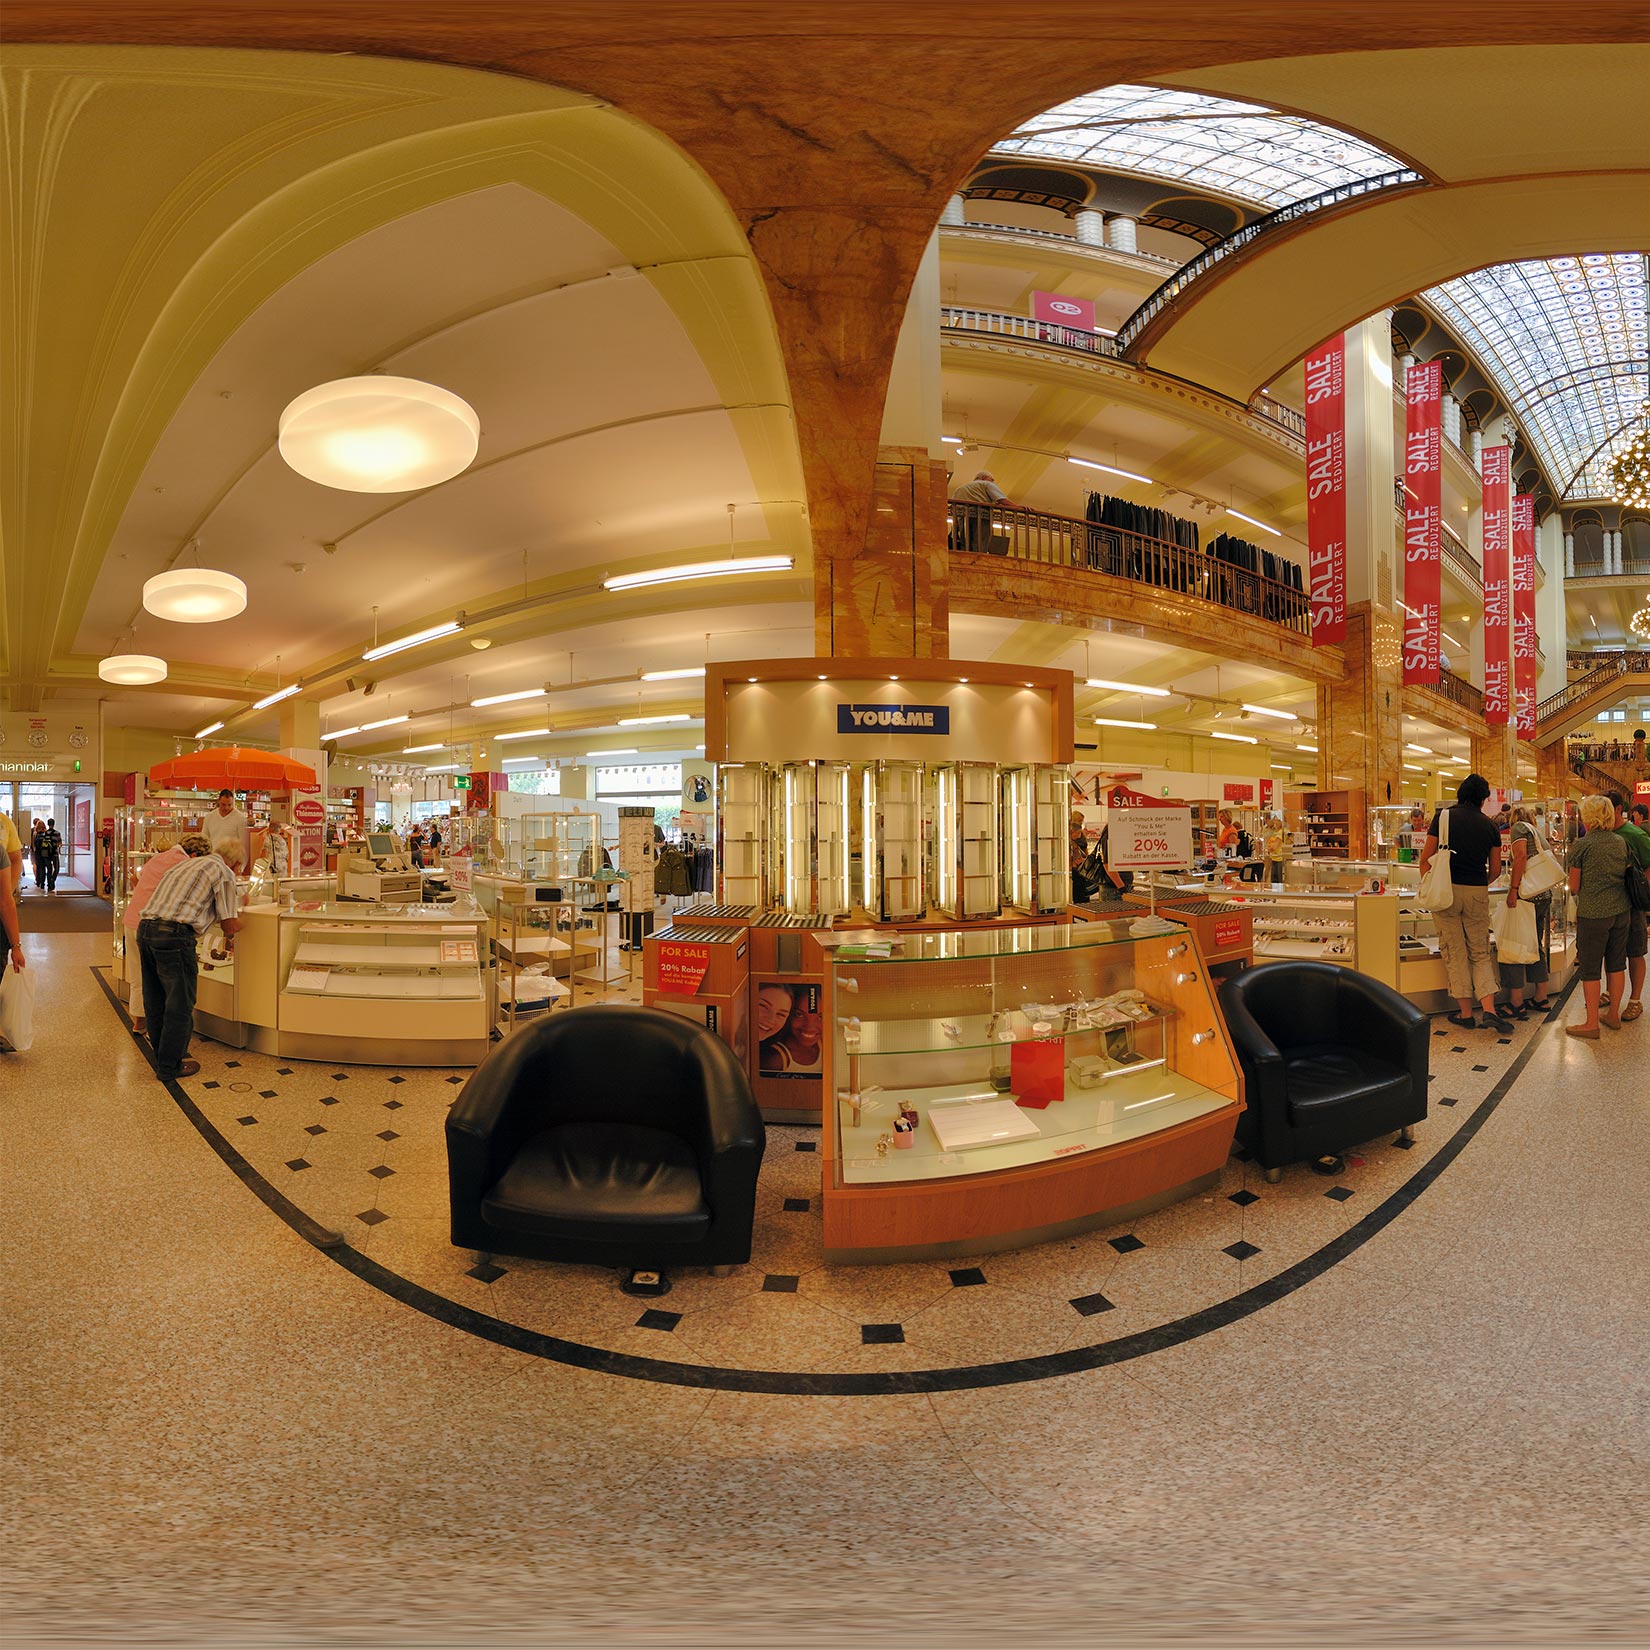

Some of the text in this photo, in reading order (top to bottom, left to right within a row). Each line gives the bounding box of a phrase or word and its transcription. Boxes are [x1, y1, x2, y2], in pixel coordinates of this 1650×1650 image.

[1307, 354, 1331, 404] SALE
[1333, 352, 1342, 395] REDUZIERT
[1409, 367, 1429, 406] SALE
[1430, 366, 1438, 400] REDUZIERT
[1309, 434, 1332, 499] SALE
[1333, 432, 1342, 491] REDUZIERT
[1408, 429, 1429, 473] SALE
[1430, 427, 1438, 471] REDUZIERT
[1484, 450, 1500, 485] SALE
[1407, 507, 1429, 561] SALE
[1430, 506, 1438, 560] REDUZIERT
[1484, 510, 1501, 550] SALE
[1512, 499, 1526, 532] SALE
[1311, 544, 1333, 627] SALE
[1335, 543, 1343, 623] REDUZIERT
[1513, 554, 1527, 591] SALE
[1485, 580, 1501, 626] SALE
[1404, 603, 1428, 669] SALE
[1429, 604, 1437, 669] REDUZIERT
[1514, 618, 1528, 658] SALE
[1486, 661, 1501, 711] SALE
[850, 711, 934, 727] YOU&ME
[1516, 687, 1529, 731] SALE
[0, 761, 55, 772] ianiplatz
[1113, 796, 1143, 807] SALE
[1264, 786, 1272, 811] ALE
[1134, 839, 1168, 852] 20%
[455, 870, 468, 882] 50%
[661, 947, 707, 959] FOR SALE
[661, 963, 680, 972] 20%
